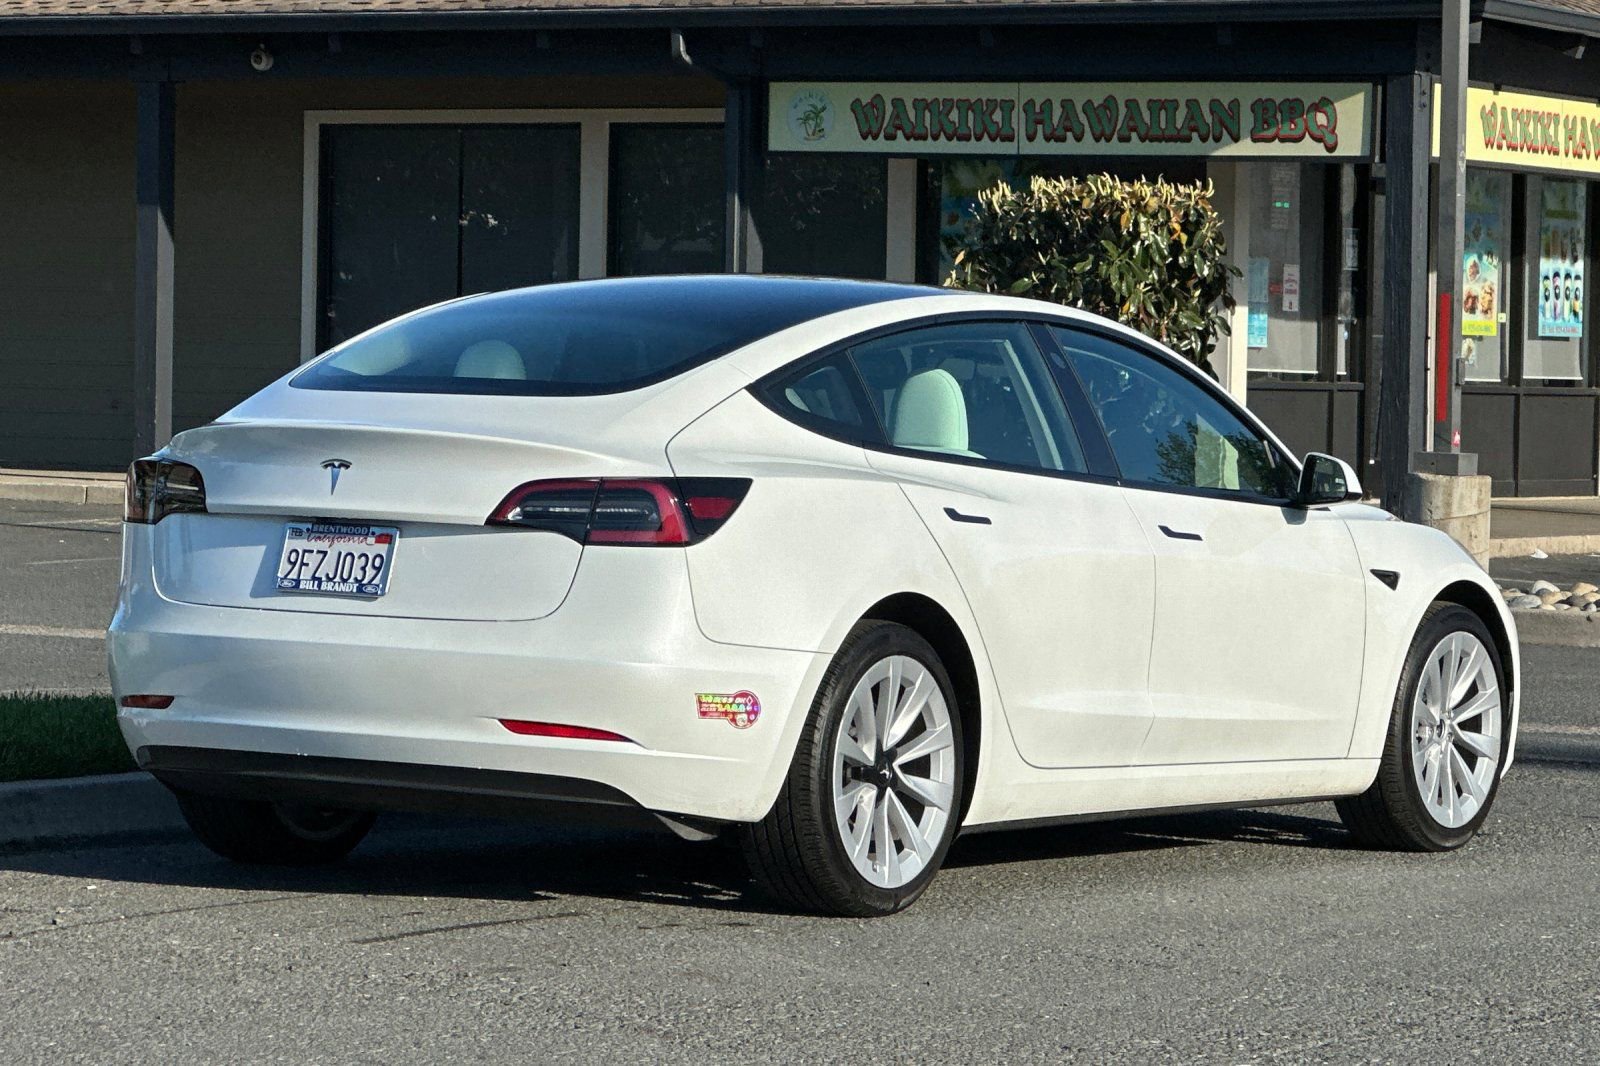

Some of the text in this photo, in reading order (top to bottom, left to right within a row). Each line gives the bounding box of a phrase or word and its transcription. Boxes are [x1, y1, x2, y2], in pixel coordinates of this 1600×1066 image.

[850, 94, 1015, 142] WAIKIKI
[1022, 95, 1241, 143] HAWAIIAN
[1250, 97, 1338, 153] BBQ
[1480, 101, 1560, 156] WAIKIKI
[306, 532, 372, 548] California
[312, 524, 369, 535] BRENTWOOD
[284, 549, 385, 584] 9FZJ039
[300, 580, 358, 592] BILL BRANDT
